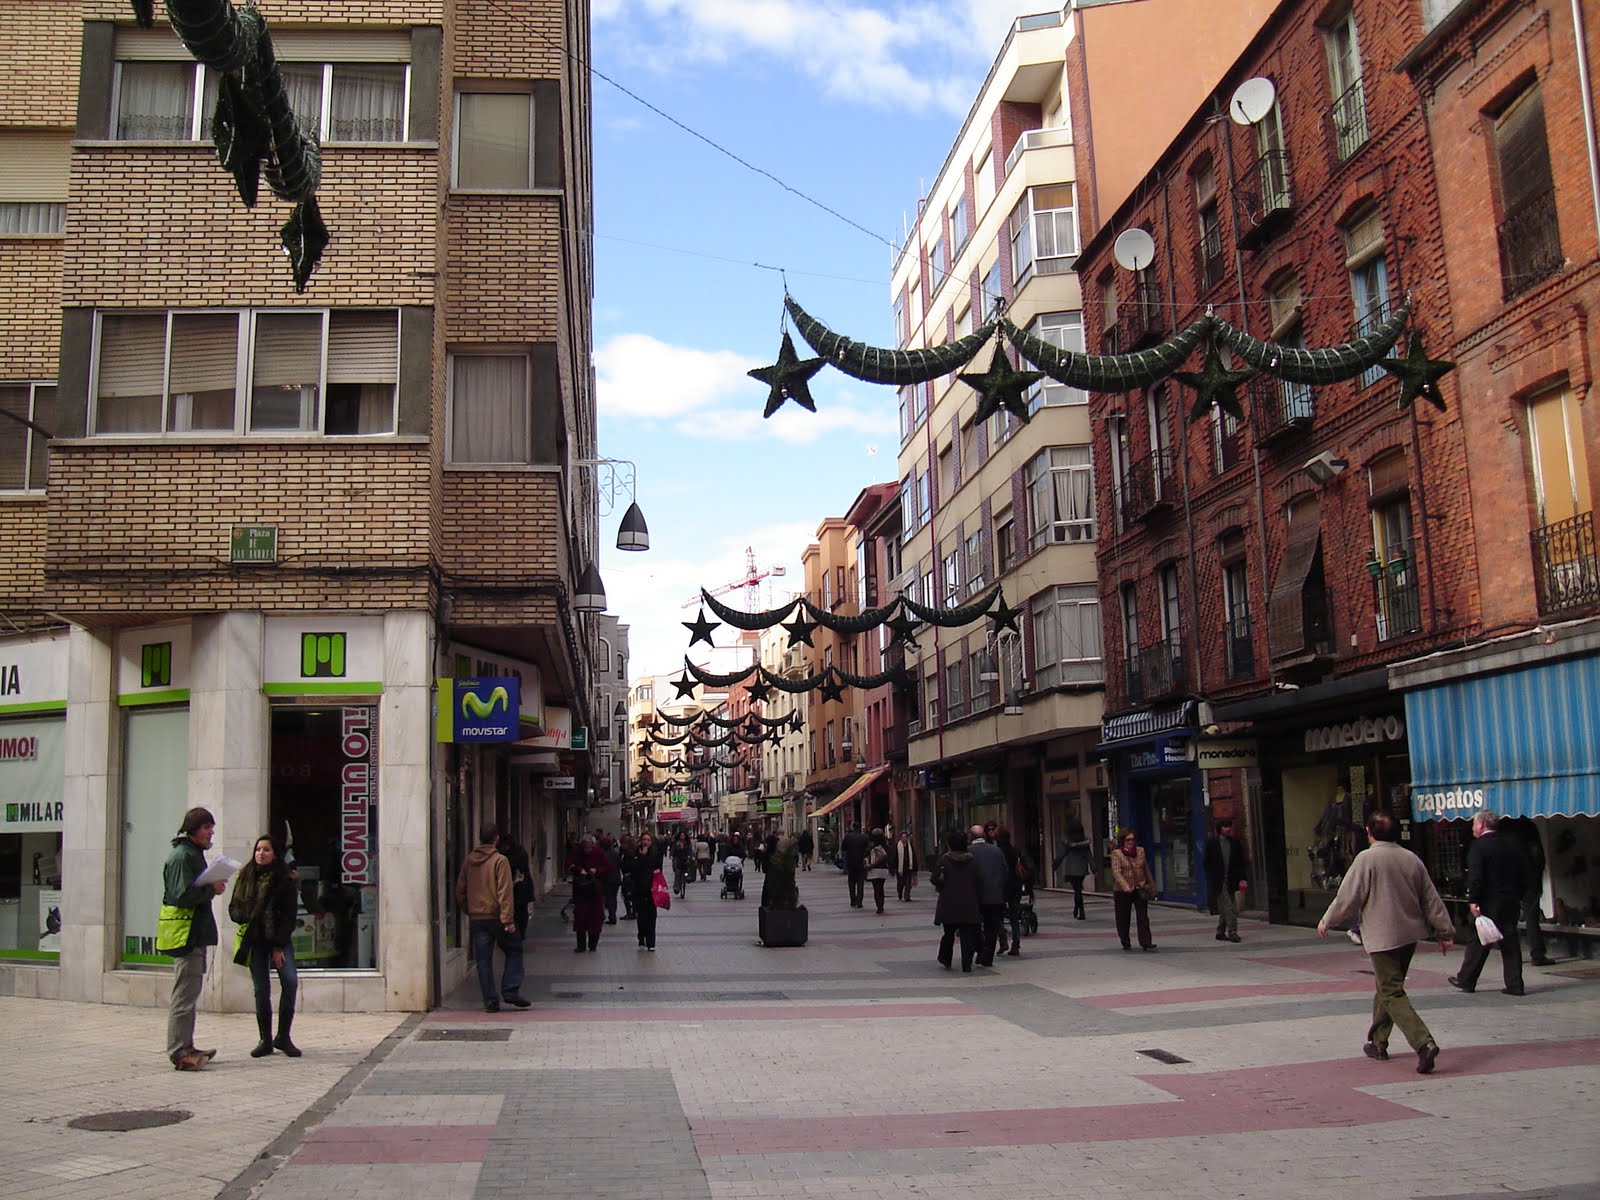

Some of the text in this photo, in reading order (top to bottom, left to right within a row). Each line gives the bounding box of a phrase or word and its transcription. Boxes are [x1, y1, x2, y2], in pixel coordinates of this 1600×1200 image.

[249, 528, 270, 537] Plaza
[462, 726, 509, 737] movistar
[1304, 714, 1401, 753] monedero
[1417, 786, 1483, 816] zapatos
[19, 802, 64, 822] MILAR
